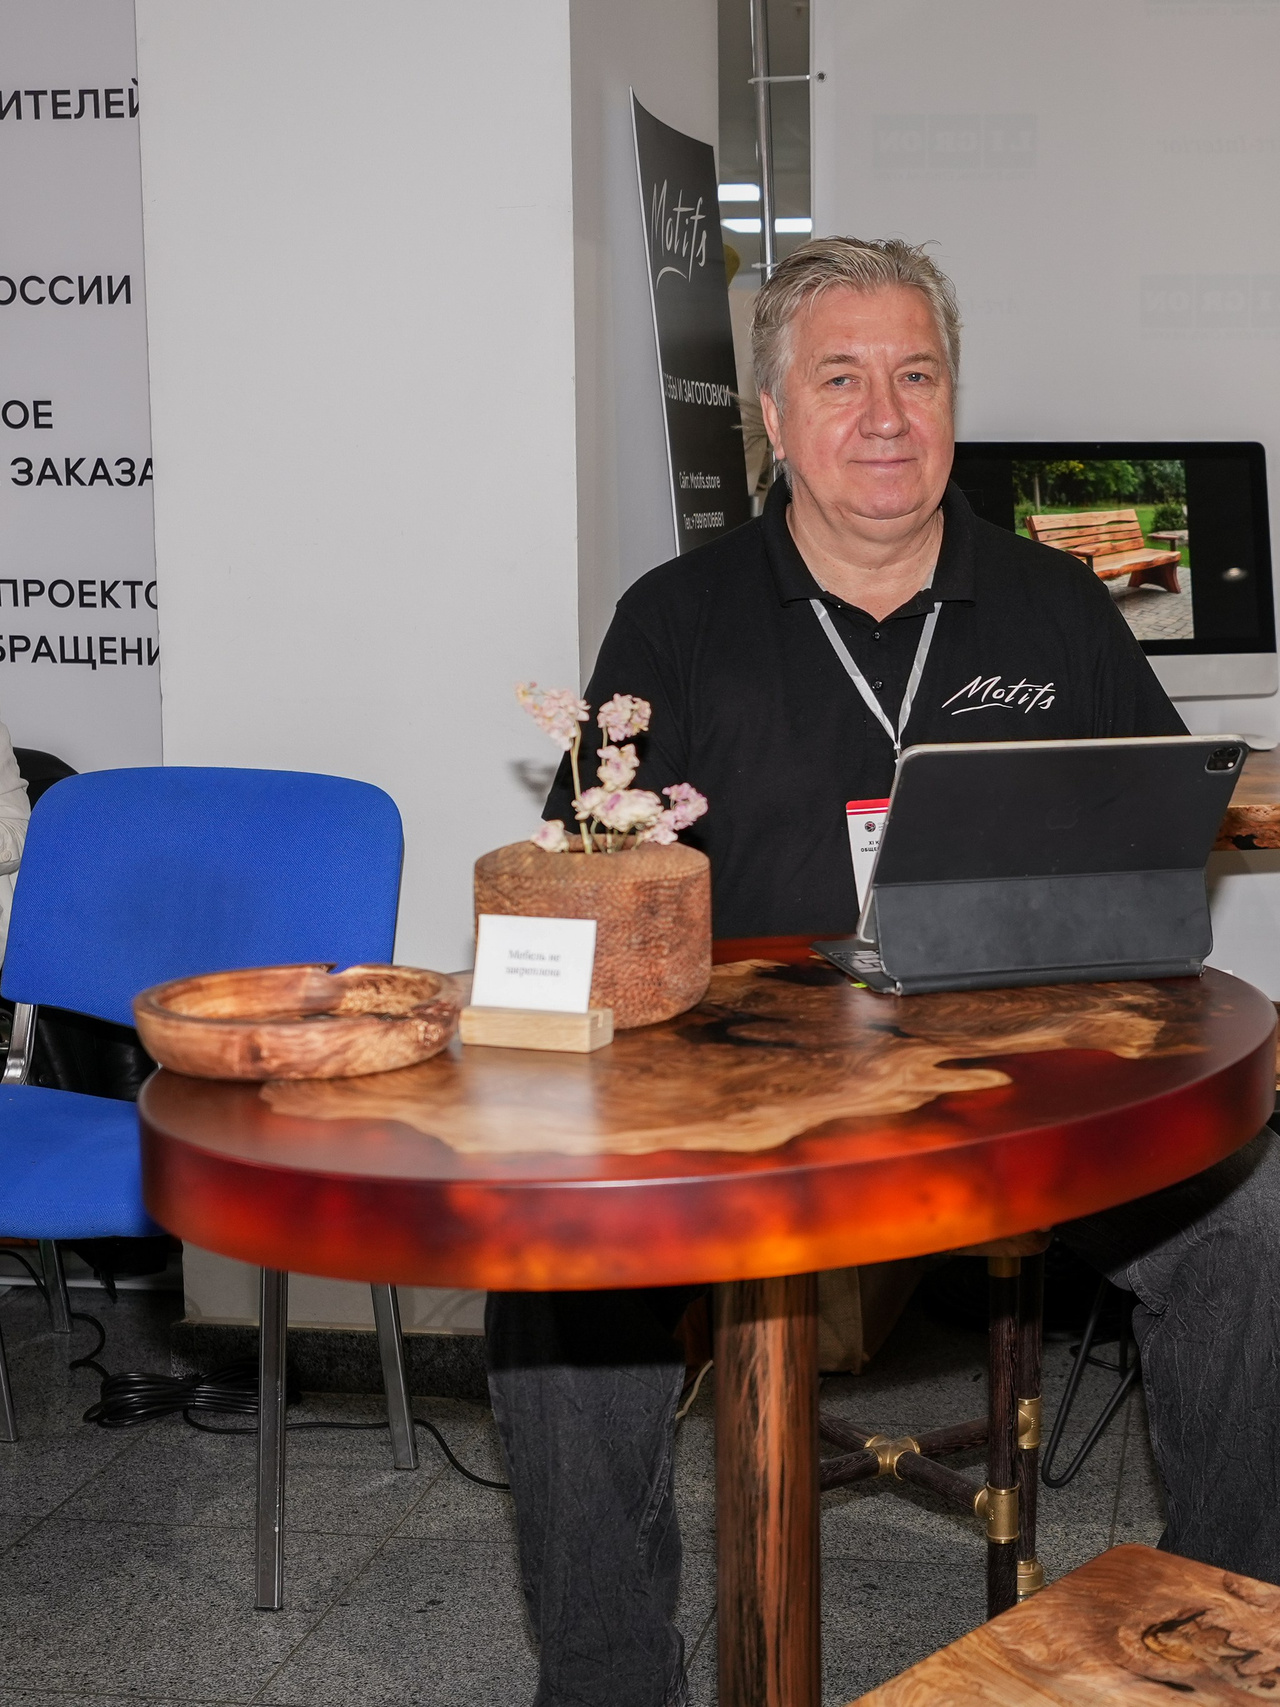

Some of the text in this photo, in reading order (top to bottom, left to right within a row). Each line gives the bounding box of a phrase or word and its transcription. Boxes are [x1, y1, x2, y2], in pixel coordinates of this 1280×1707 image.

[651, 179, 706, 282] Motifs
[683, 379, 731, 407] ЗАГОТОВКИ
[1, 399, 53, 429] ОЕ
[0, 635, 159, 670] РАЩЕНИ
[941, 676, 1056, 714] Motifs
